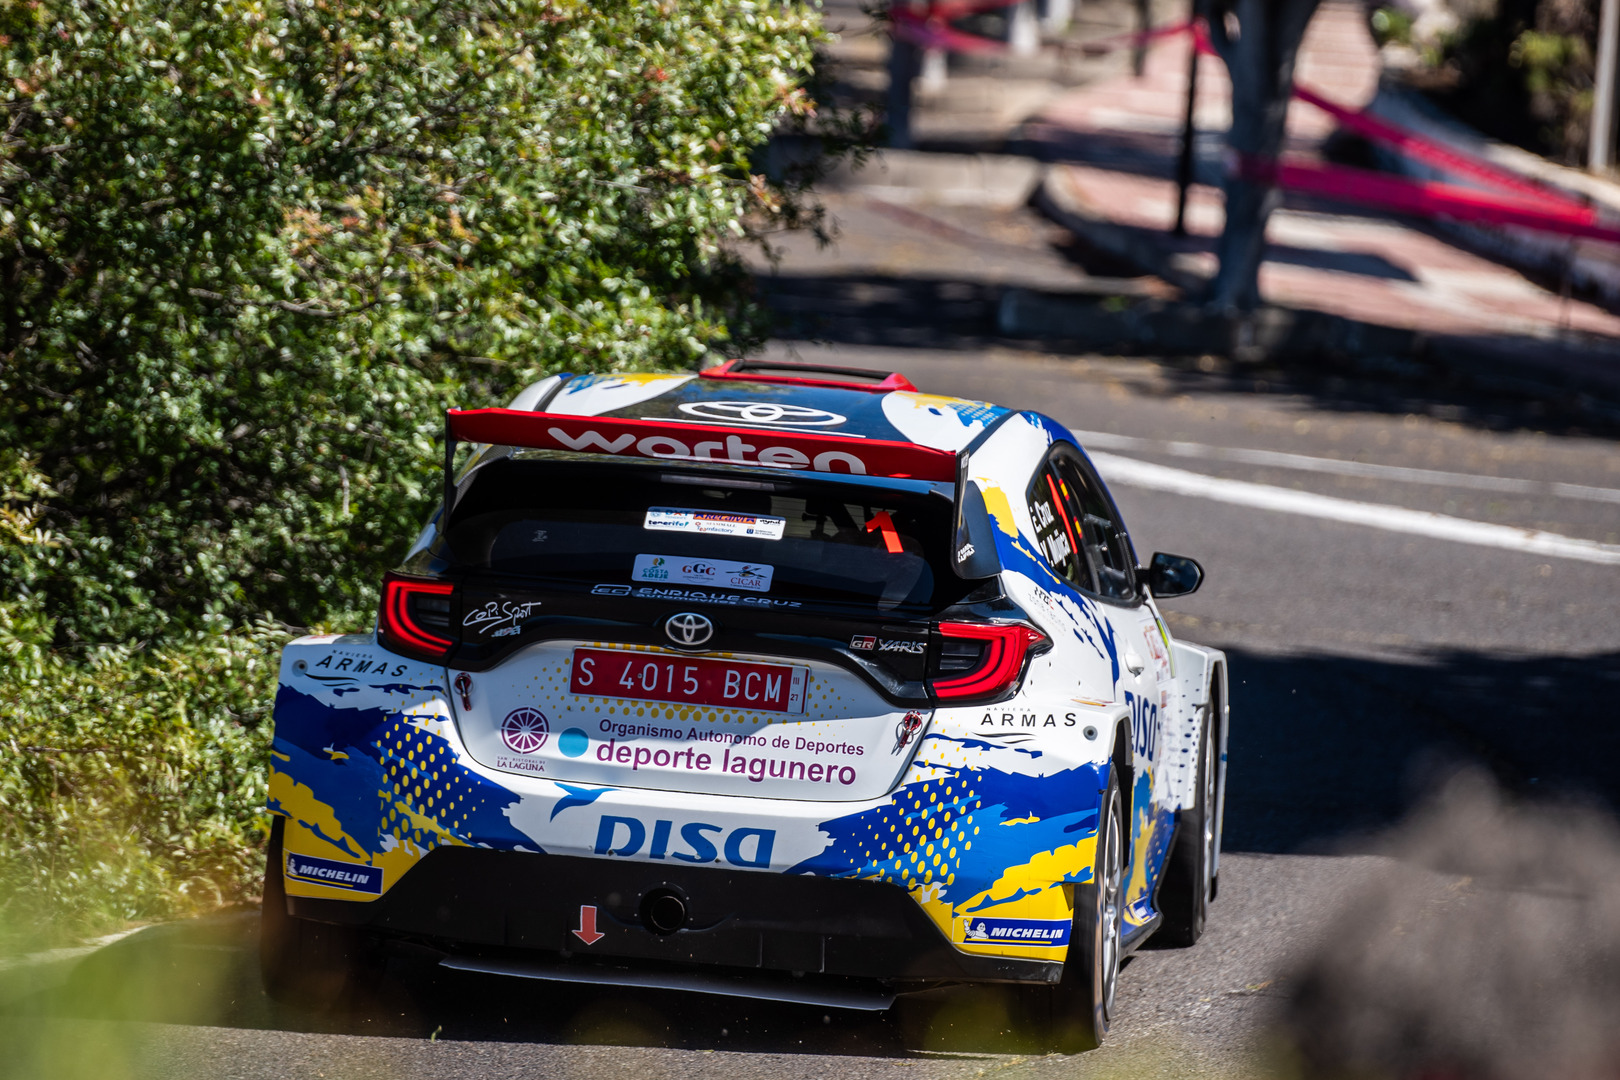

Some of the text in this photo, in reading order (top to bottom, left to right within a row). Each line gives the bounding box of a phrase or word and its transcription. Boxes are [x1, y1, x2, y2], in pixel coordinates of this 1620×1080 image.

[547, 427, 867, 475] worten
[865, 511, 904, 553] 1
[682, 563, 716, 576] GGC
[731, 577, 761, 587] CICAR
[638, 587, 802, 608] ENRIQUE CRUZ
[332, 649, 373, 659] NAVIERA
[850, 638, 927, 654] GR YARIS
[315, 655, 408, 677] ARMAS
[578, 657, 782, 703] S 4015 BCM
[980, 712, 1077, 727] ARMAS
[599, 718, 865, 757] Organismo Autonomo de Deportes
[497, 760, 545, 772] LA LAGUNA
[596, 738, 857, 786] deporte lagunero
[299, 864, 369, 884] MICHELIN
[990, 927, 1064, 939] MICHELIN
